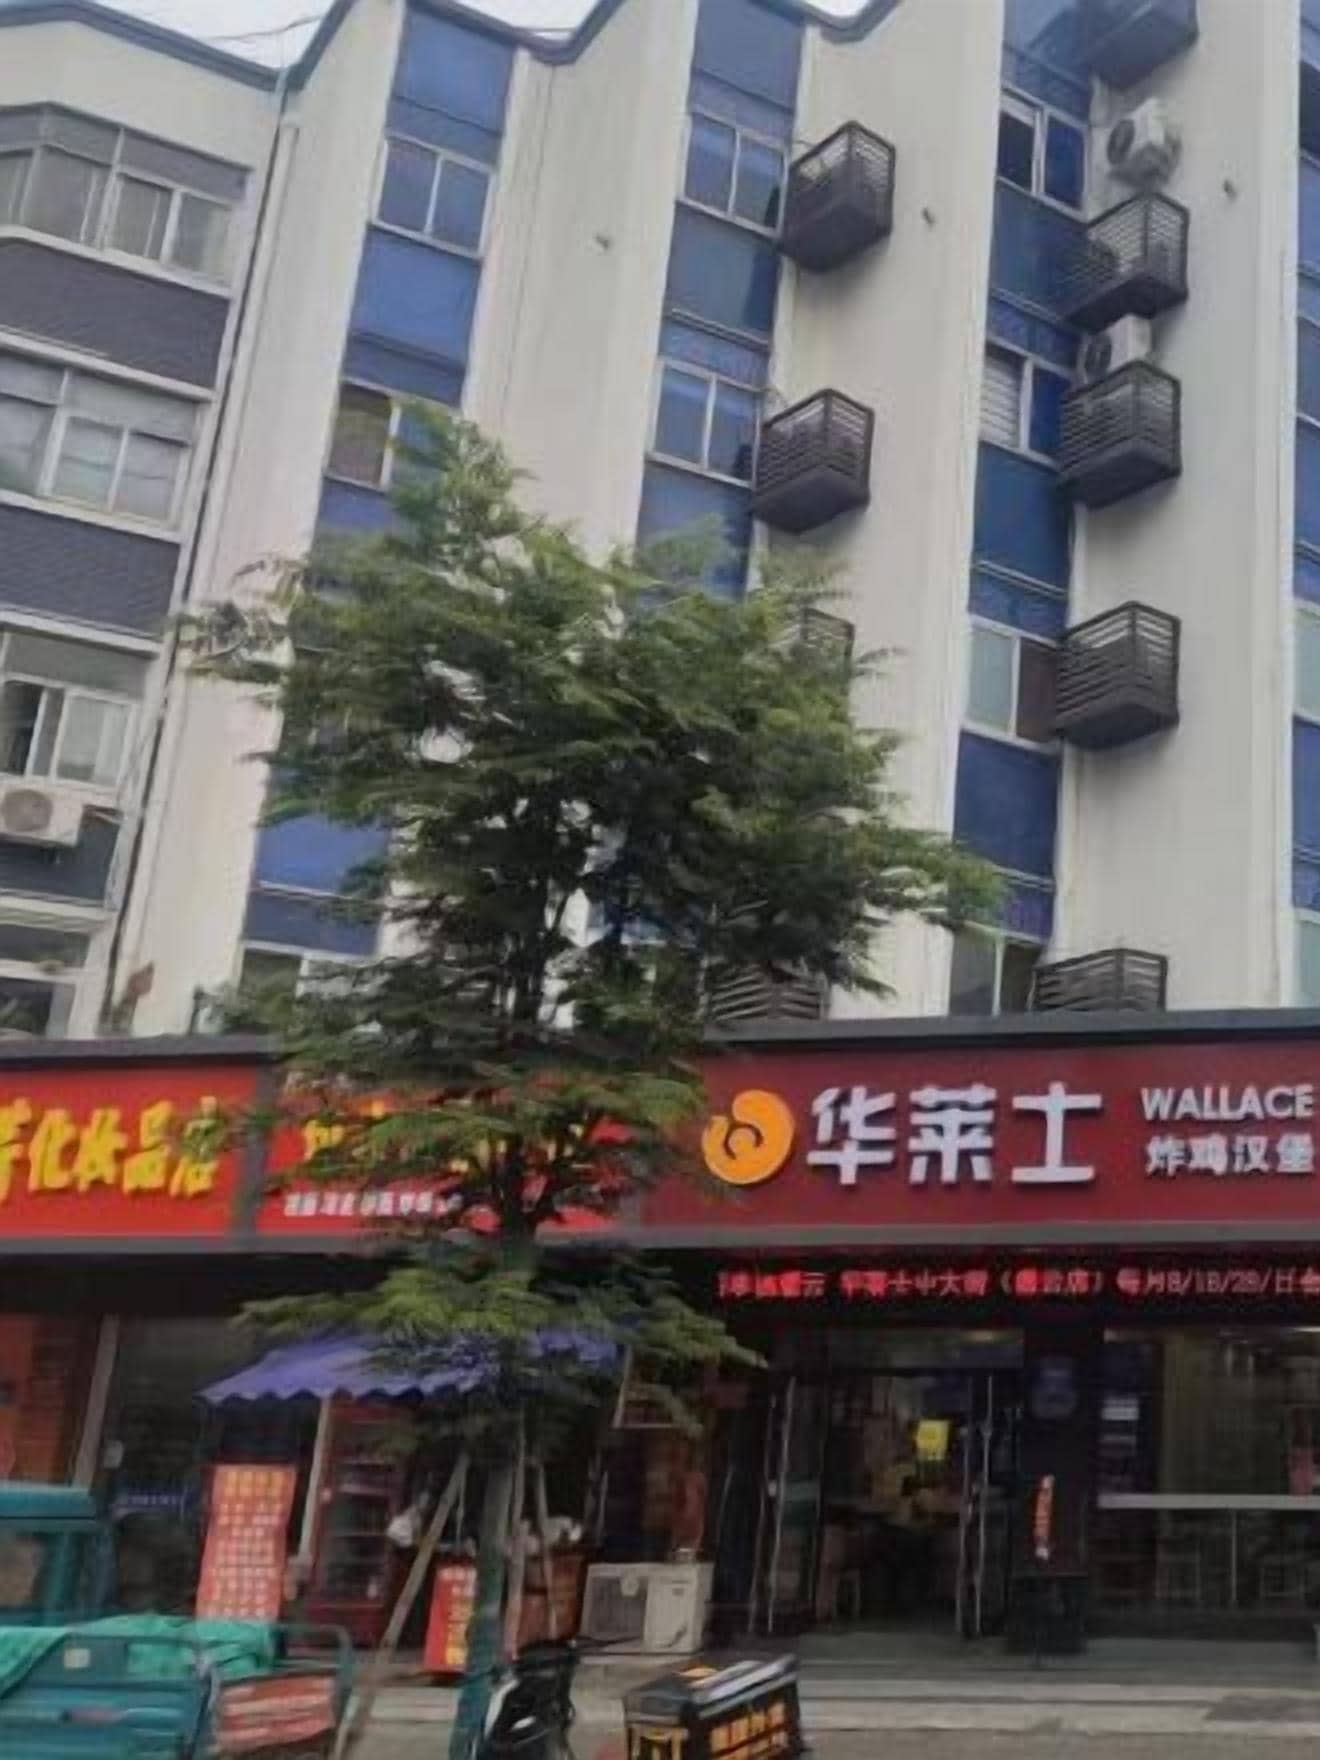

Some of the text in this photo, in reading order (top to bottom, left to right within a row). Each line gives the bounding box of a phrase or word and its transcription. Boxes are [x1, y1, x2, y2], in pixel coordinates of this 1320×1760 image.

[1140, 1083, 1315, 1121] WALLACE
[805, 1081, 1103, 1187] 华莱士
[1145, 1131, 1315, 1177] 炸鸡汉堡
